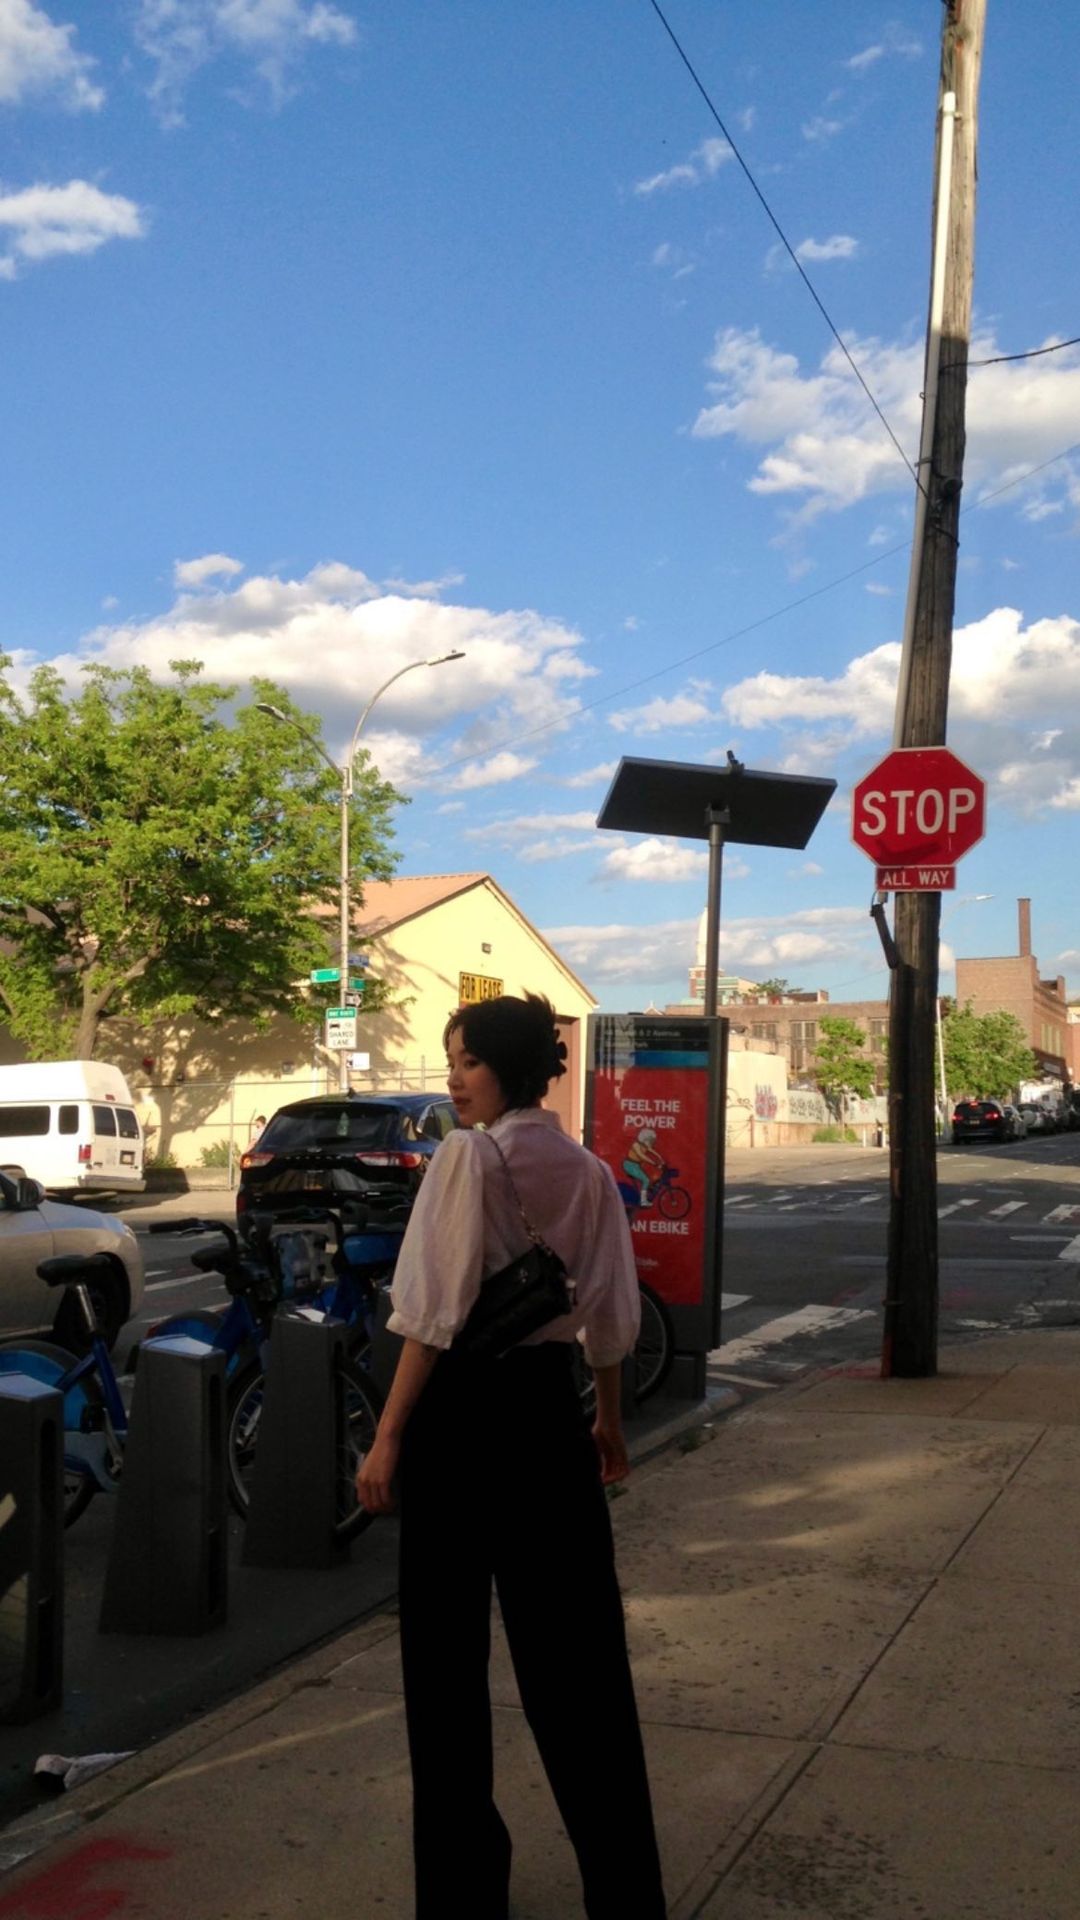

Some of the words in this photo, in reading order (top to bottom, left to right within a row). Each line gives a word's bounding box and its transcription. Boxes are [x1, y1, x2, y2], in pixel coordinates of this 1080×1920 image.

[860, 788, 976, 836] STOP
[882, 872, 911, 886] ALL
[919, 871, 949, 886] WAY
[461, 975, 476, 1000] FOR
[620, 1099, 652, 1112] FEEL
[654, 1100, 681, 1113] THE
[624, 1115, 676, 1129] POWER
[649, 1221, 689, 1235] EBIKE
